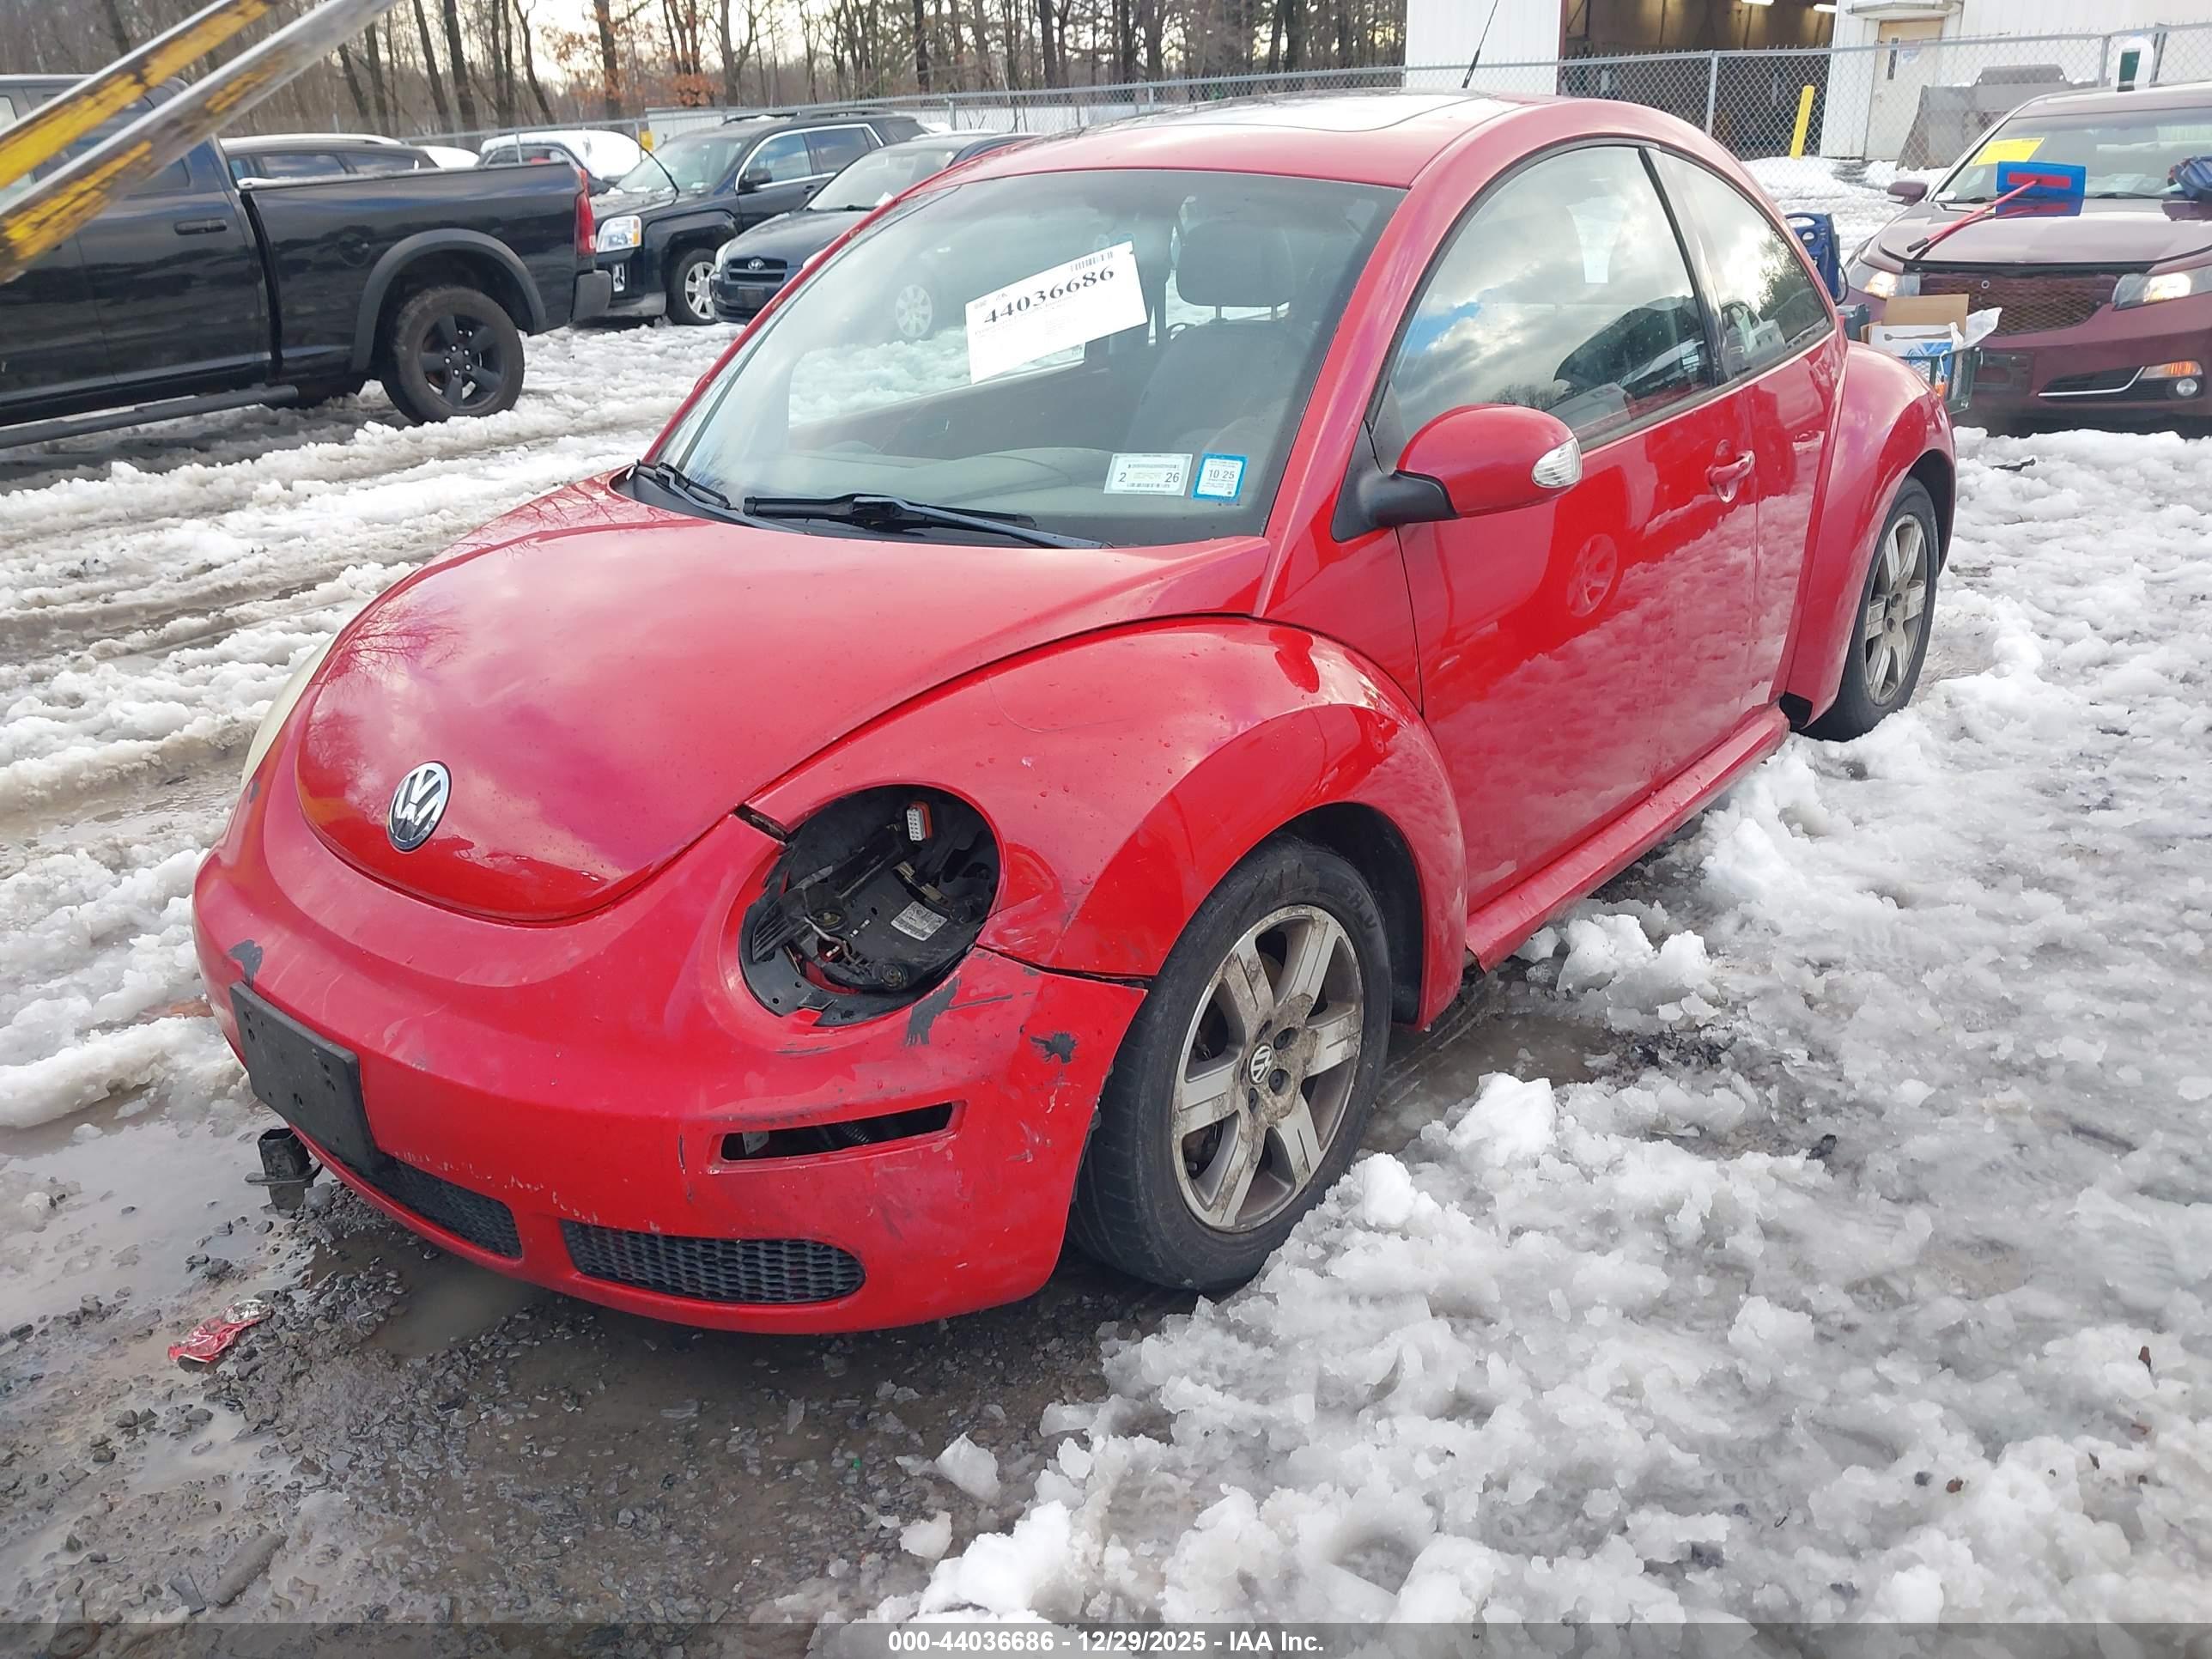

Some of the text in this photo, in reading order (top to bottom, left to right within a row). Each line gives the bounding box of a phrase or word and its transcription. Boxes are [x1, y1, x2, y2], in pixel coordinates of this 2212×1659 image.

[984, 265, 1115, 324] 44036686
[1118, 472, 1180, 483] 2 26
[1208, 468, 1235, 479] 10 25
[389, 763, 448, 848] VW
